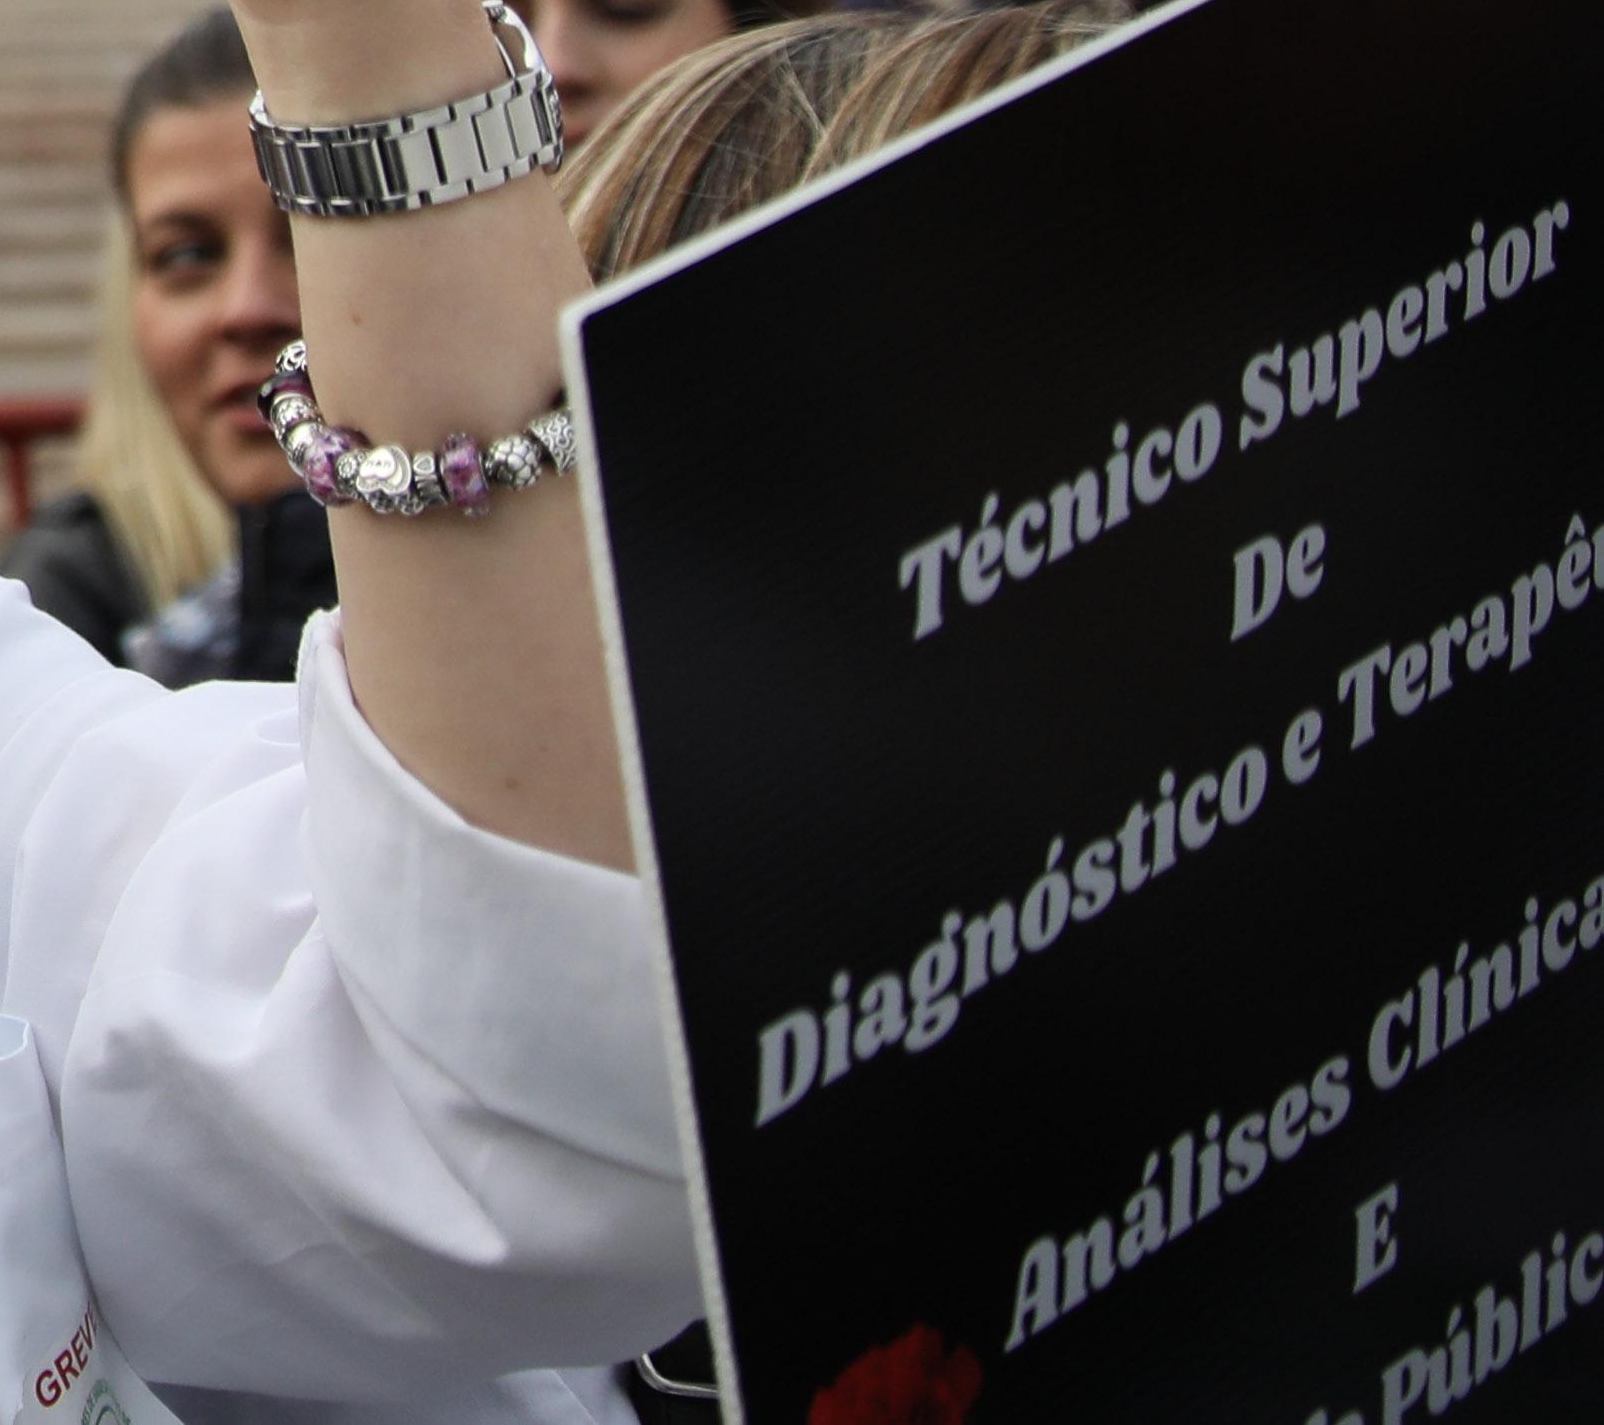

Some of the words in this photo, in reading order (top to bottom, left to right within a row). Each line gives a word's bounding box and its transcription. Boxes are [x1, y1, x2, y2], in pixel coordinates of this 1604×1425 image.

[899, 400, 1224, 642] Técnico
[1239, 199, 1572, 453] Superior
[1230, 521, 1326, 643] De
[753, 745, 1268, 1127] Diagnóstico
[1282, 708, 1323, 784] e
[1337, 512, 1604, 749] Terapê
[1005, 1056, 1350, 1353] Análises
[1353, 1183, 1398, 1294] E
